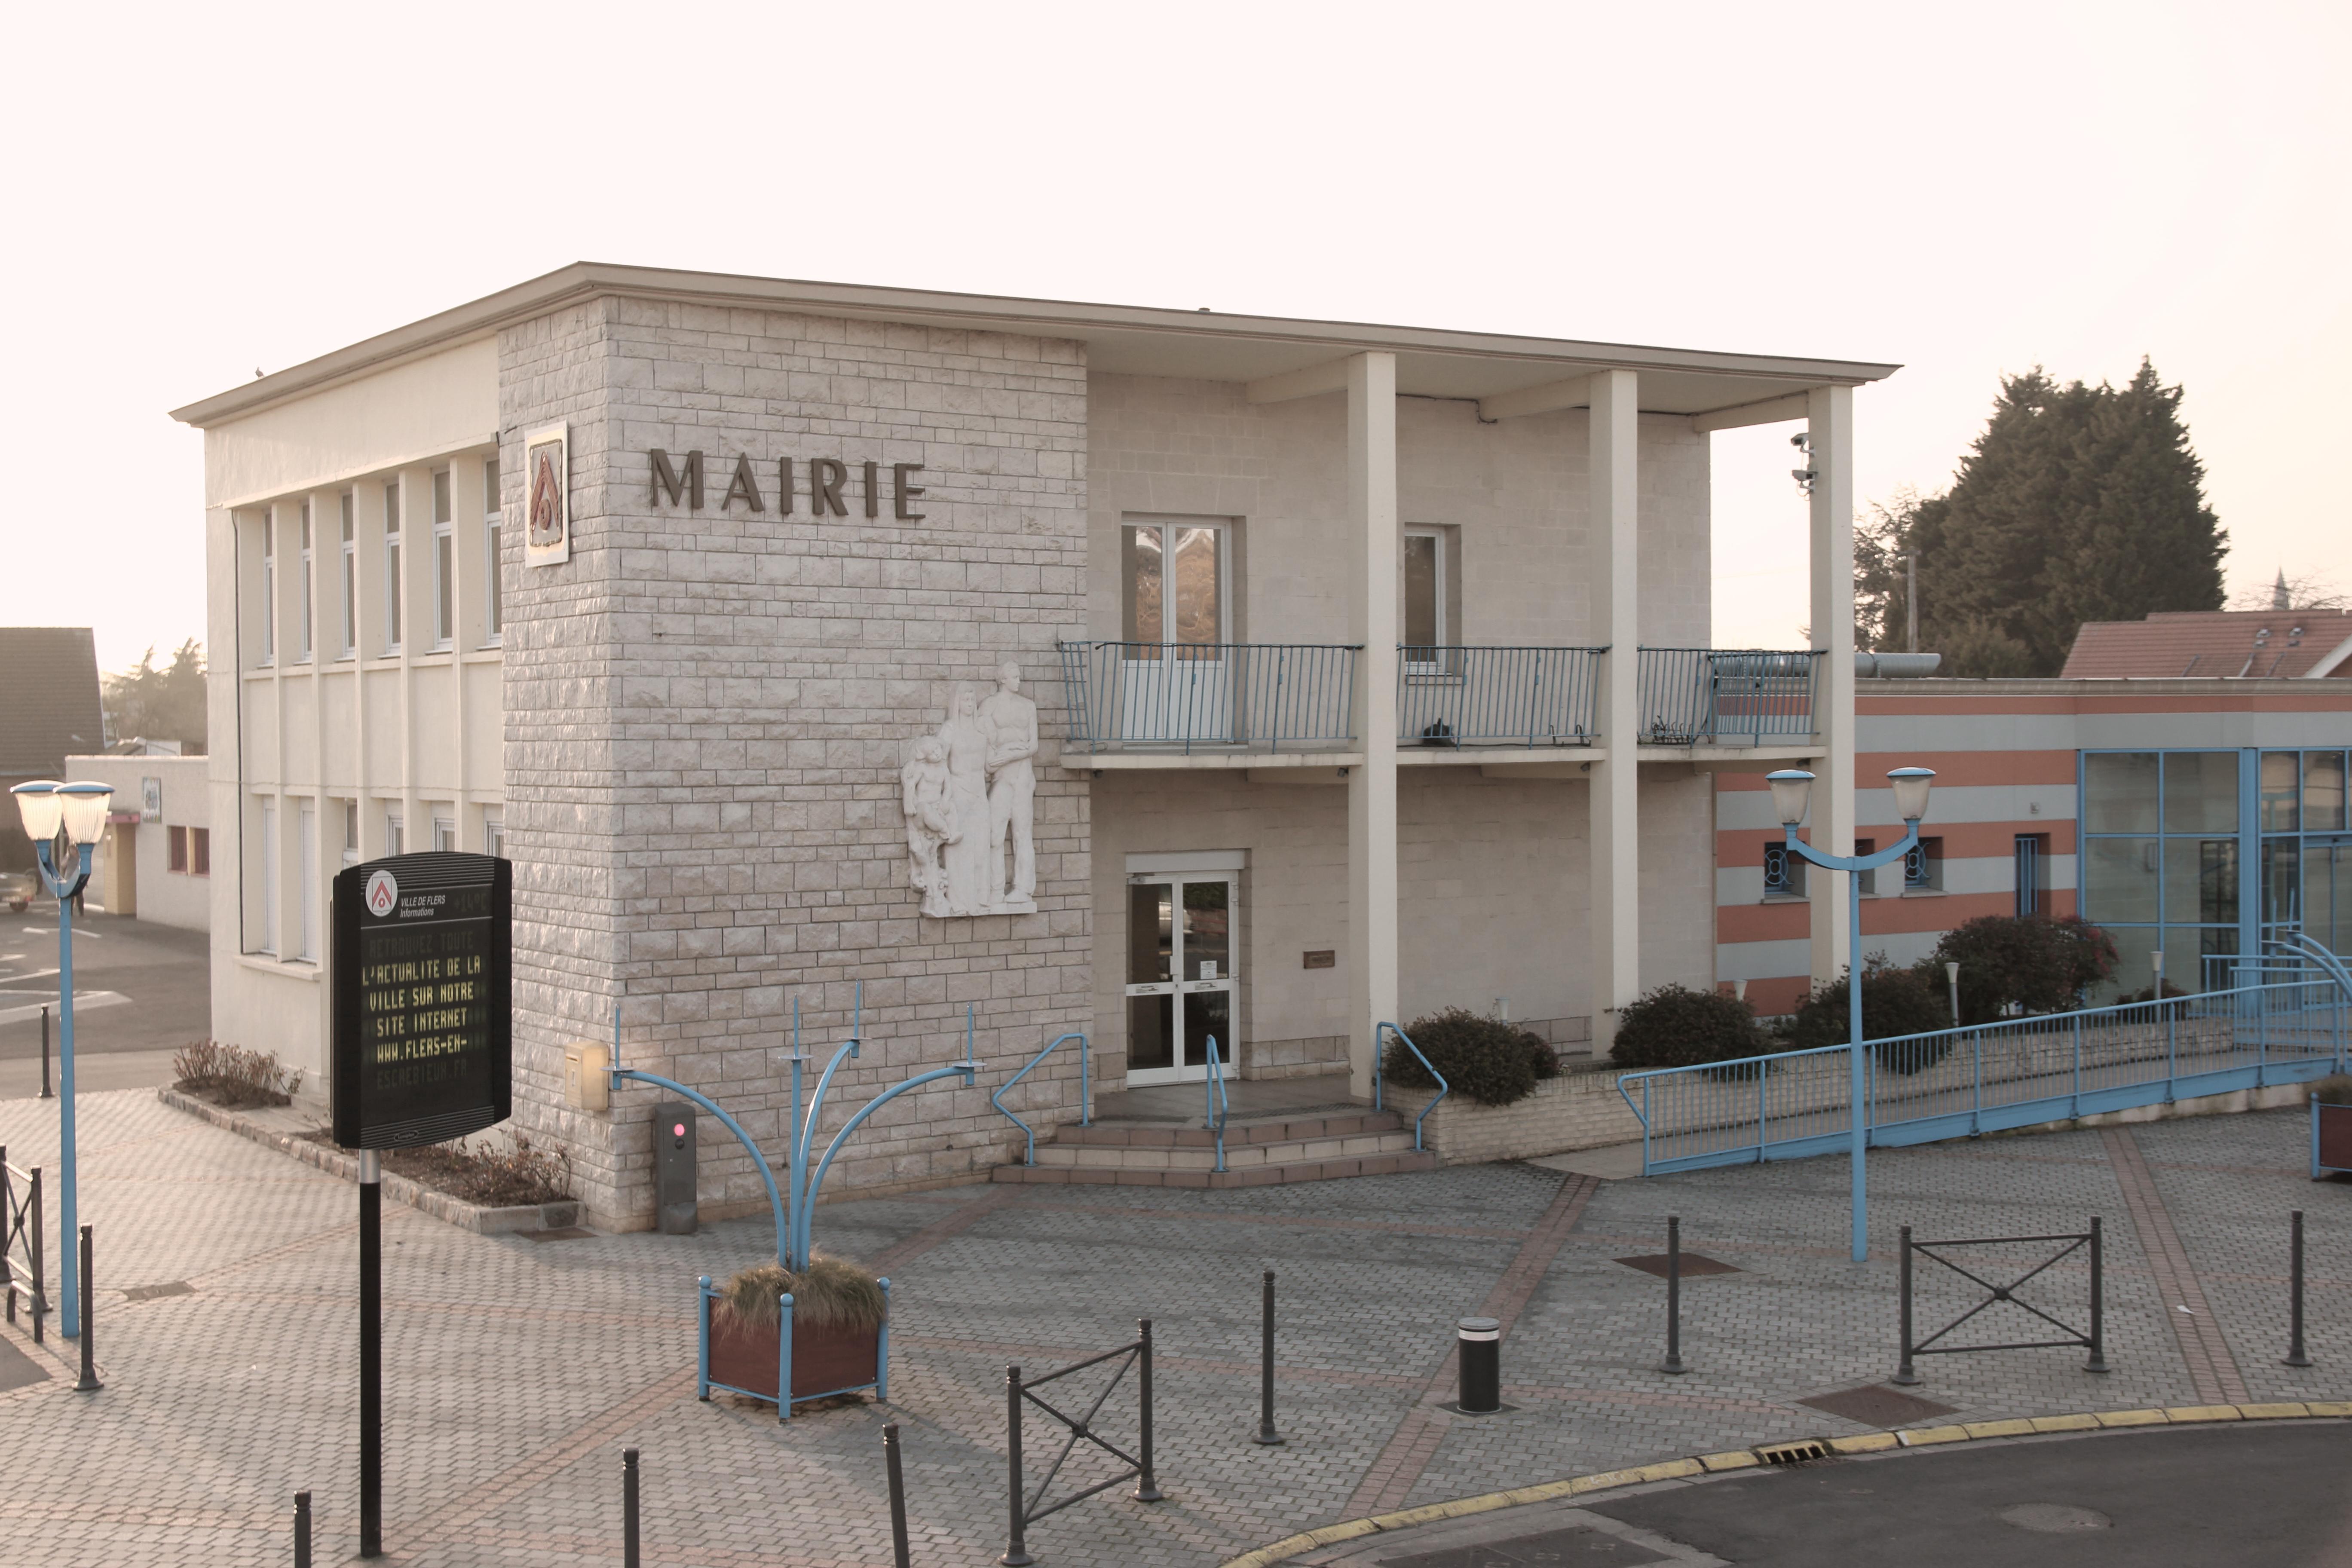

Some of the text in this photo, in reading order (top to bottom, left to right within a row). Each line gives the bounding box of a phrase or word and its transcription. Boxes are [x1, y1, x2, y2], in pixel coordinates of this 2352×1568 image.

[650, 447, 926, 519] MAIRIE
[400, 906, 434, 918] Informations
[401, 894, 446, 907] VILLE DE FLERS
[369, 931, 474, 959] RETROUVEZ TOUTE
[362, 955, 481, 986] L'ACTUALITE DE LA
[370, 980, 474, 1012] VILLE SUR NOTRE
[377, 1007, 467, 1038] SITE INTERNET
[377, 1033, 467, 1064] WWW.FLERS-EN-
